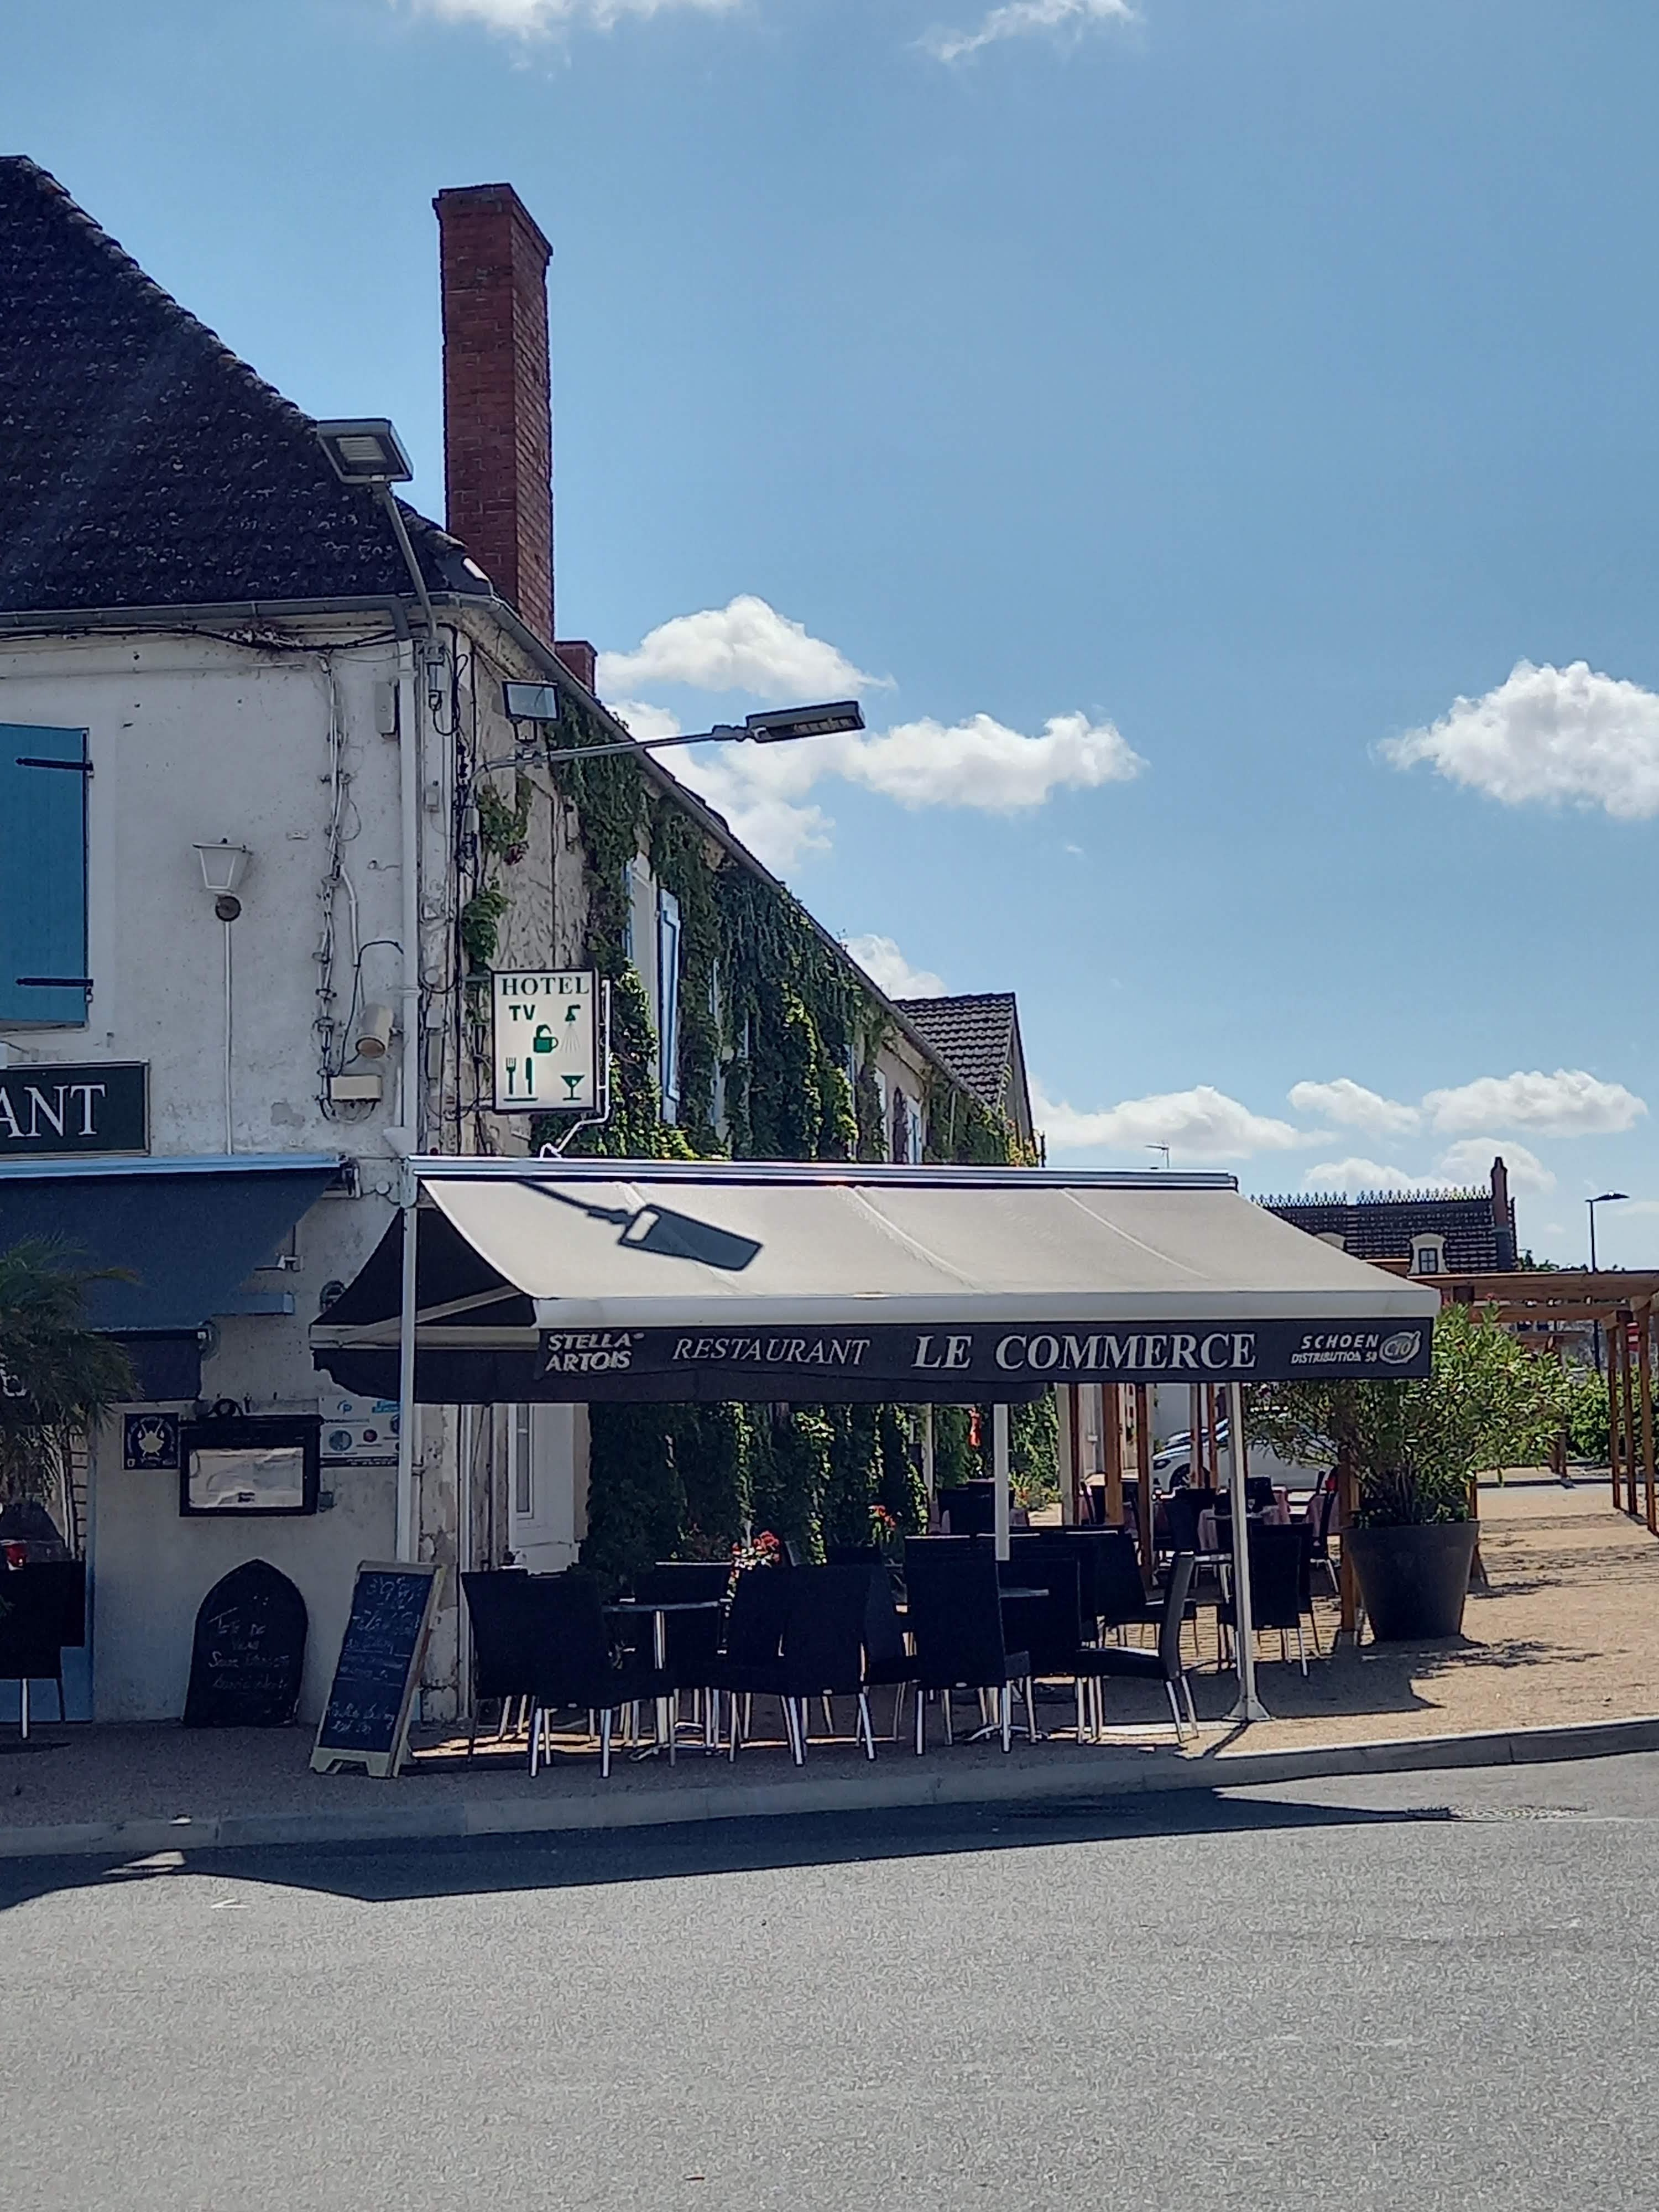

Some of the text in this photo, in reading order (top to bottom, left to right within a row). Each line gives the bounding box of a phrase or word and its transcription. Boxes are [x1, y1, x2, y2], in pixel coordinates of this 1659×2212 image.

[501, 977, 589, 995] HOTEL
[508, 1004, 535, 1021] TV
[548, 1333, 632, 1351] STELLA
[1301, 1334, 1379, 1349] SCHOEN
[672, 1333, 1256, 1370] RESTAURANT LE COMMERCE
[545, 1350, 632, 1372] ARTOIS
